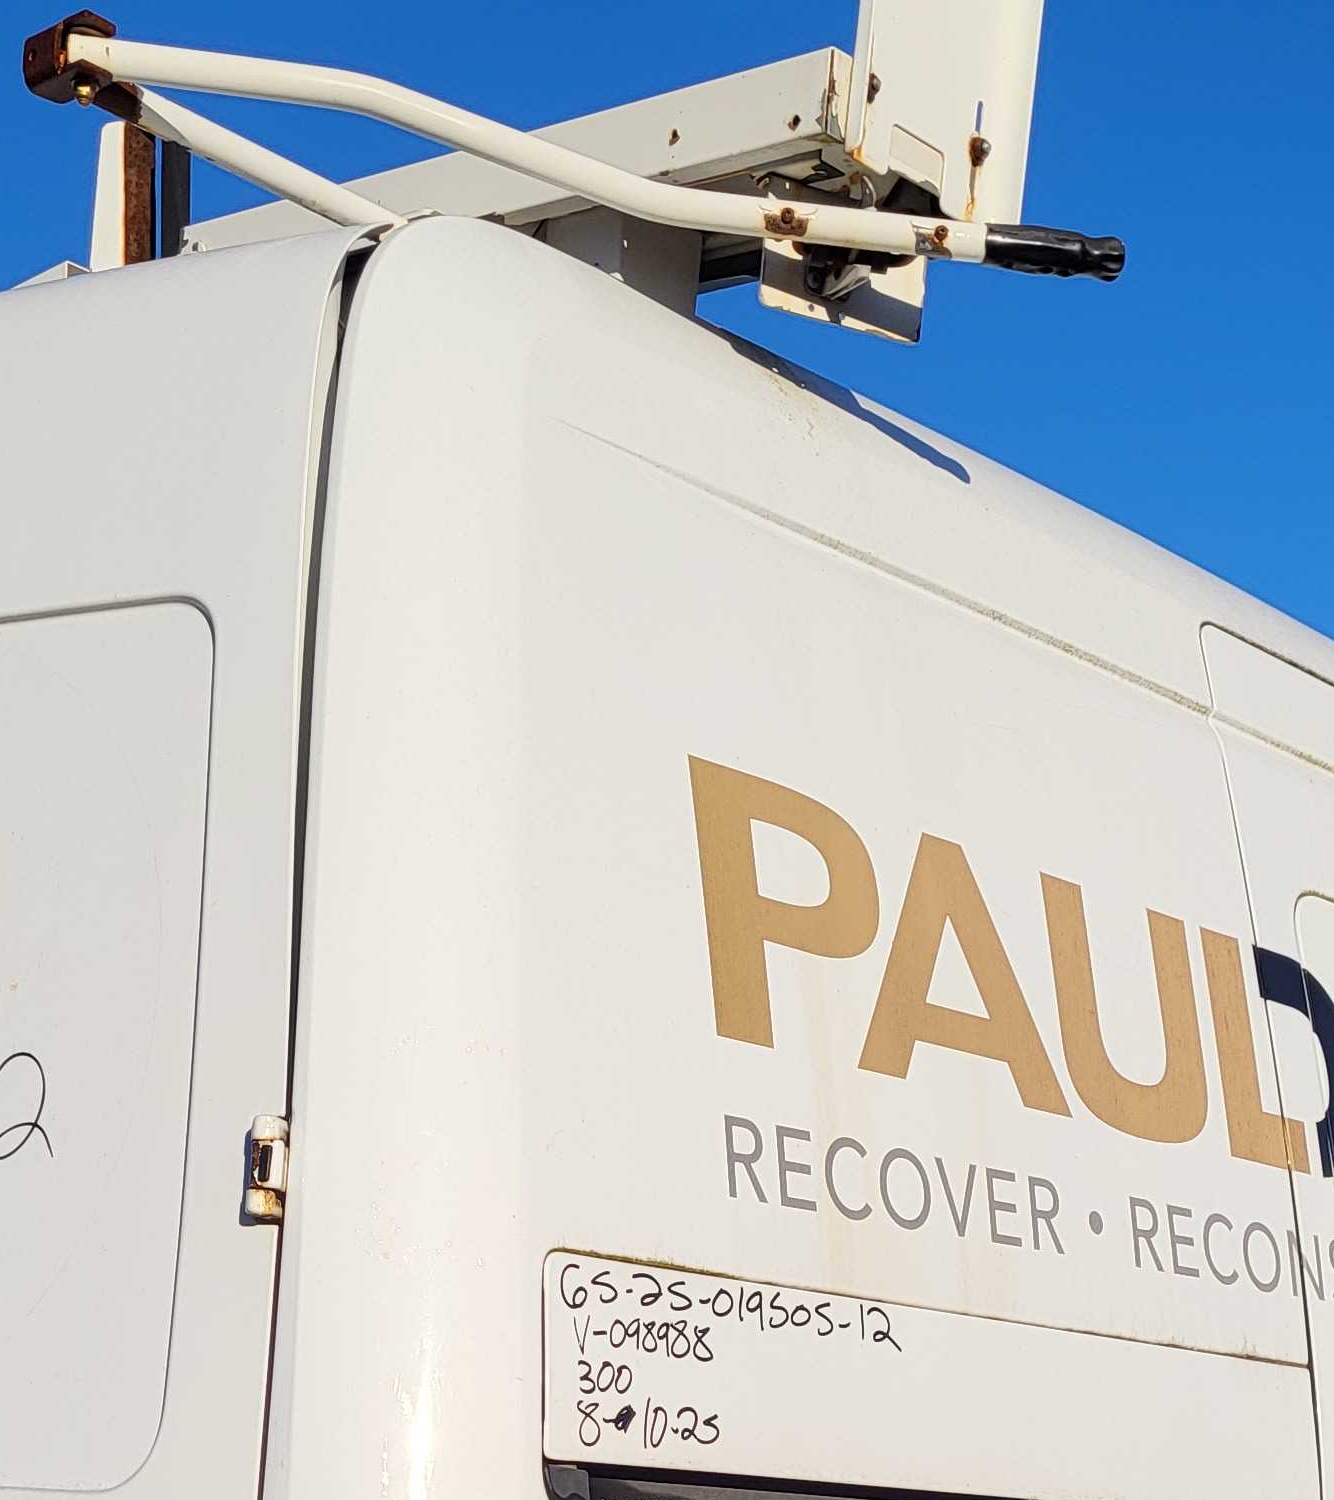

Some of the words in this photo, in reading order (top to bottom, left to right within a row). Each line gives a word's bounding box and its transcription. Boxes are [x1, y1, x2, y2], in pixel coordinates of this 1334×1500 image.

[688, 754, 1310, 1174] PAUL
[724, 1114, 1065, 1255] RECOVER
[578, 1360, 633, 1395] 300
